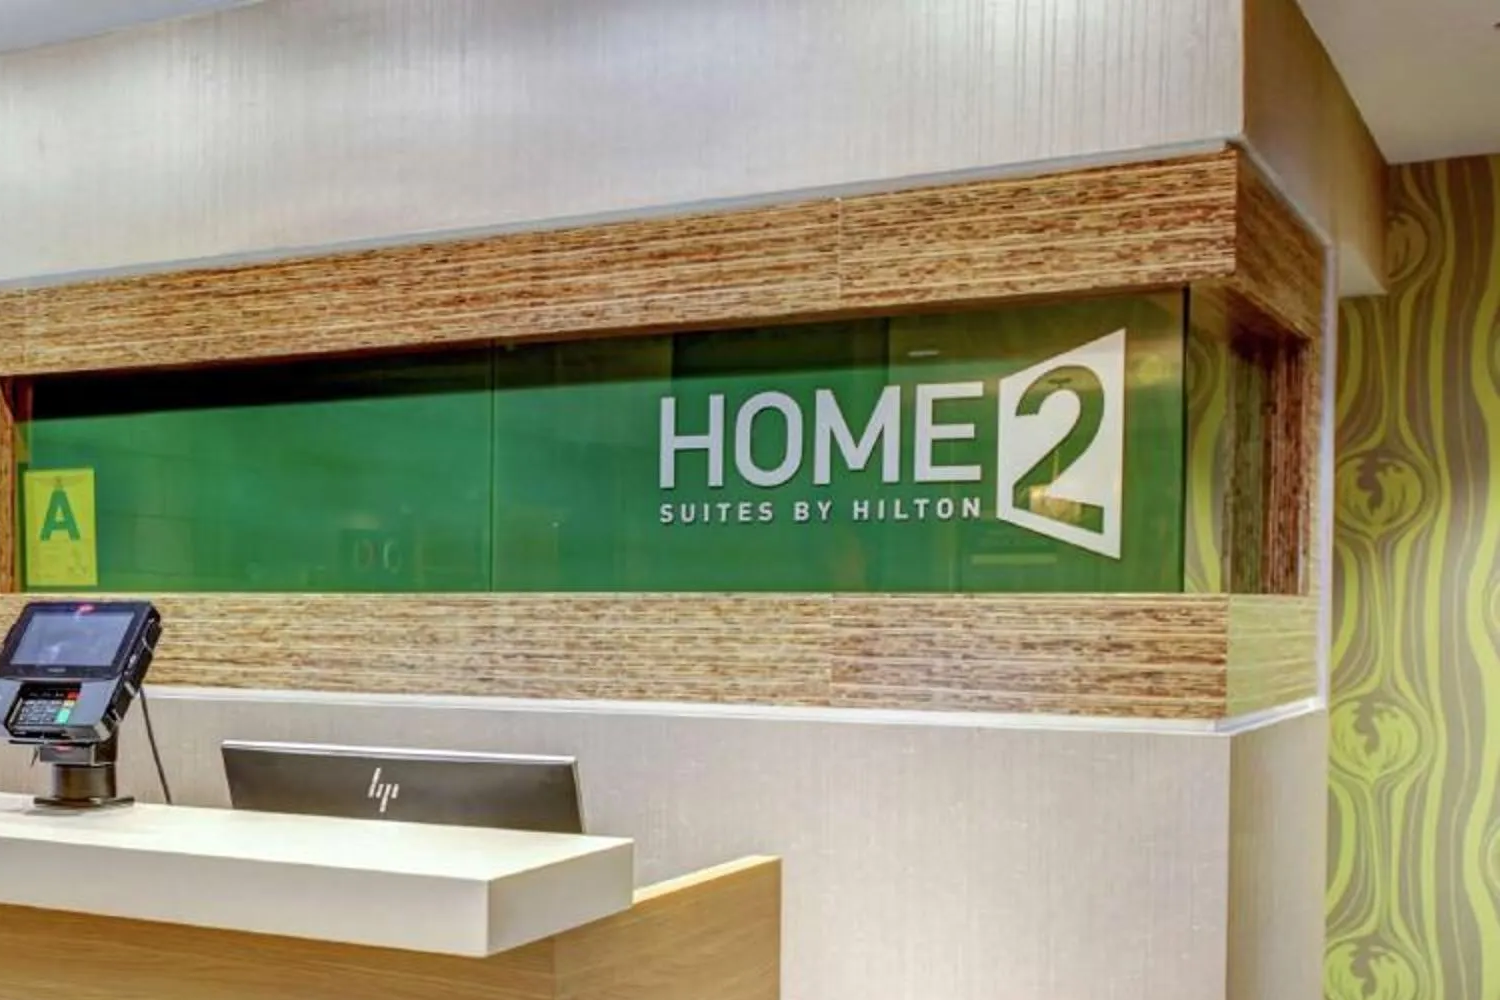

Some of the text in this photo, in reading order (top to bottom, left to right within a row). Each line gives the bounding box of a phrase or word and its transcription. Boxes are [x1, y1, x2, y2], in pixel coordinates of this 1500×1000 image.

[659, 381, 985, 490] HOME
[40, 488, 81, 541] A
[659, 497, 982, 524] SUITES BY HILTON
[368, 767, 399, 813] hp
